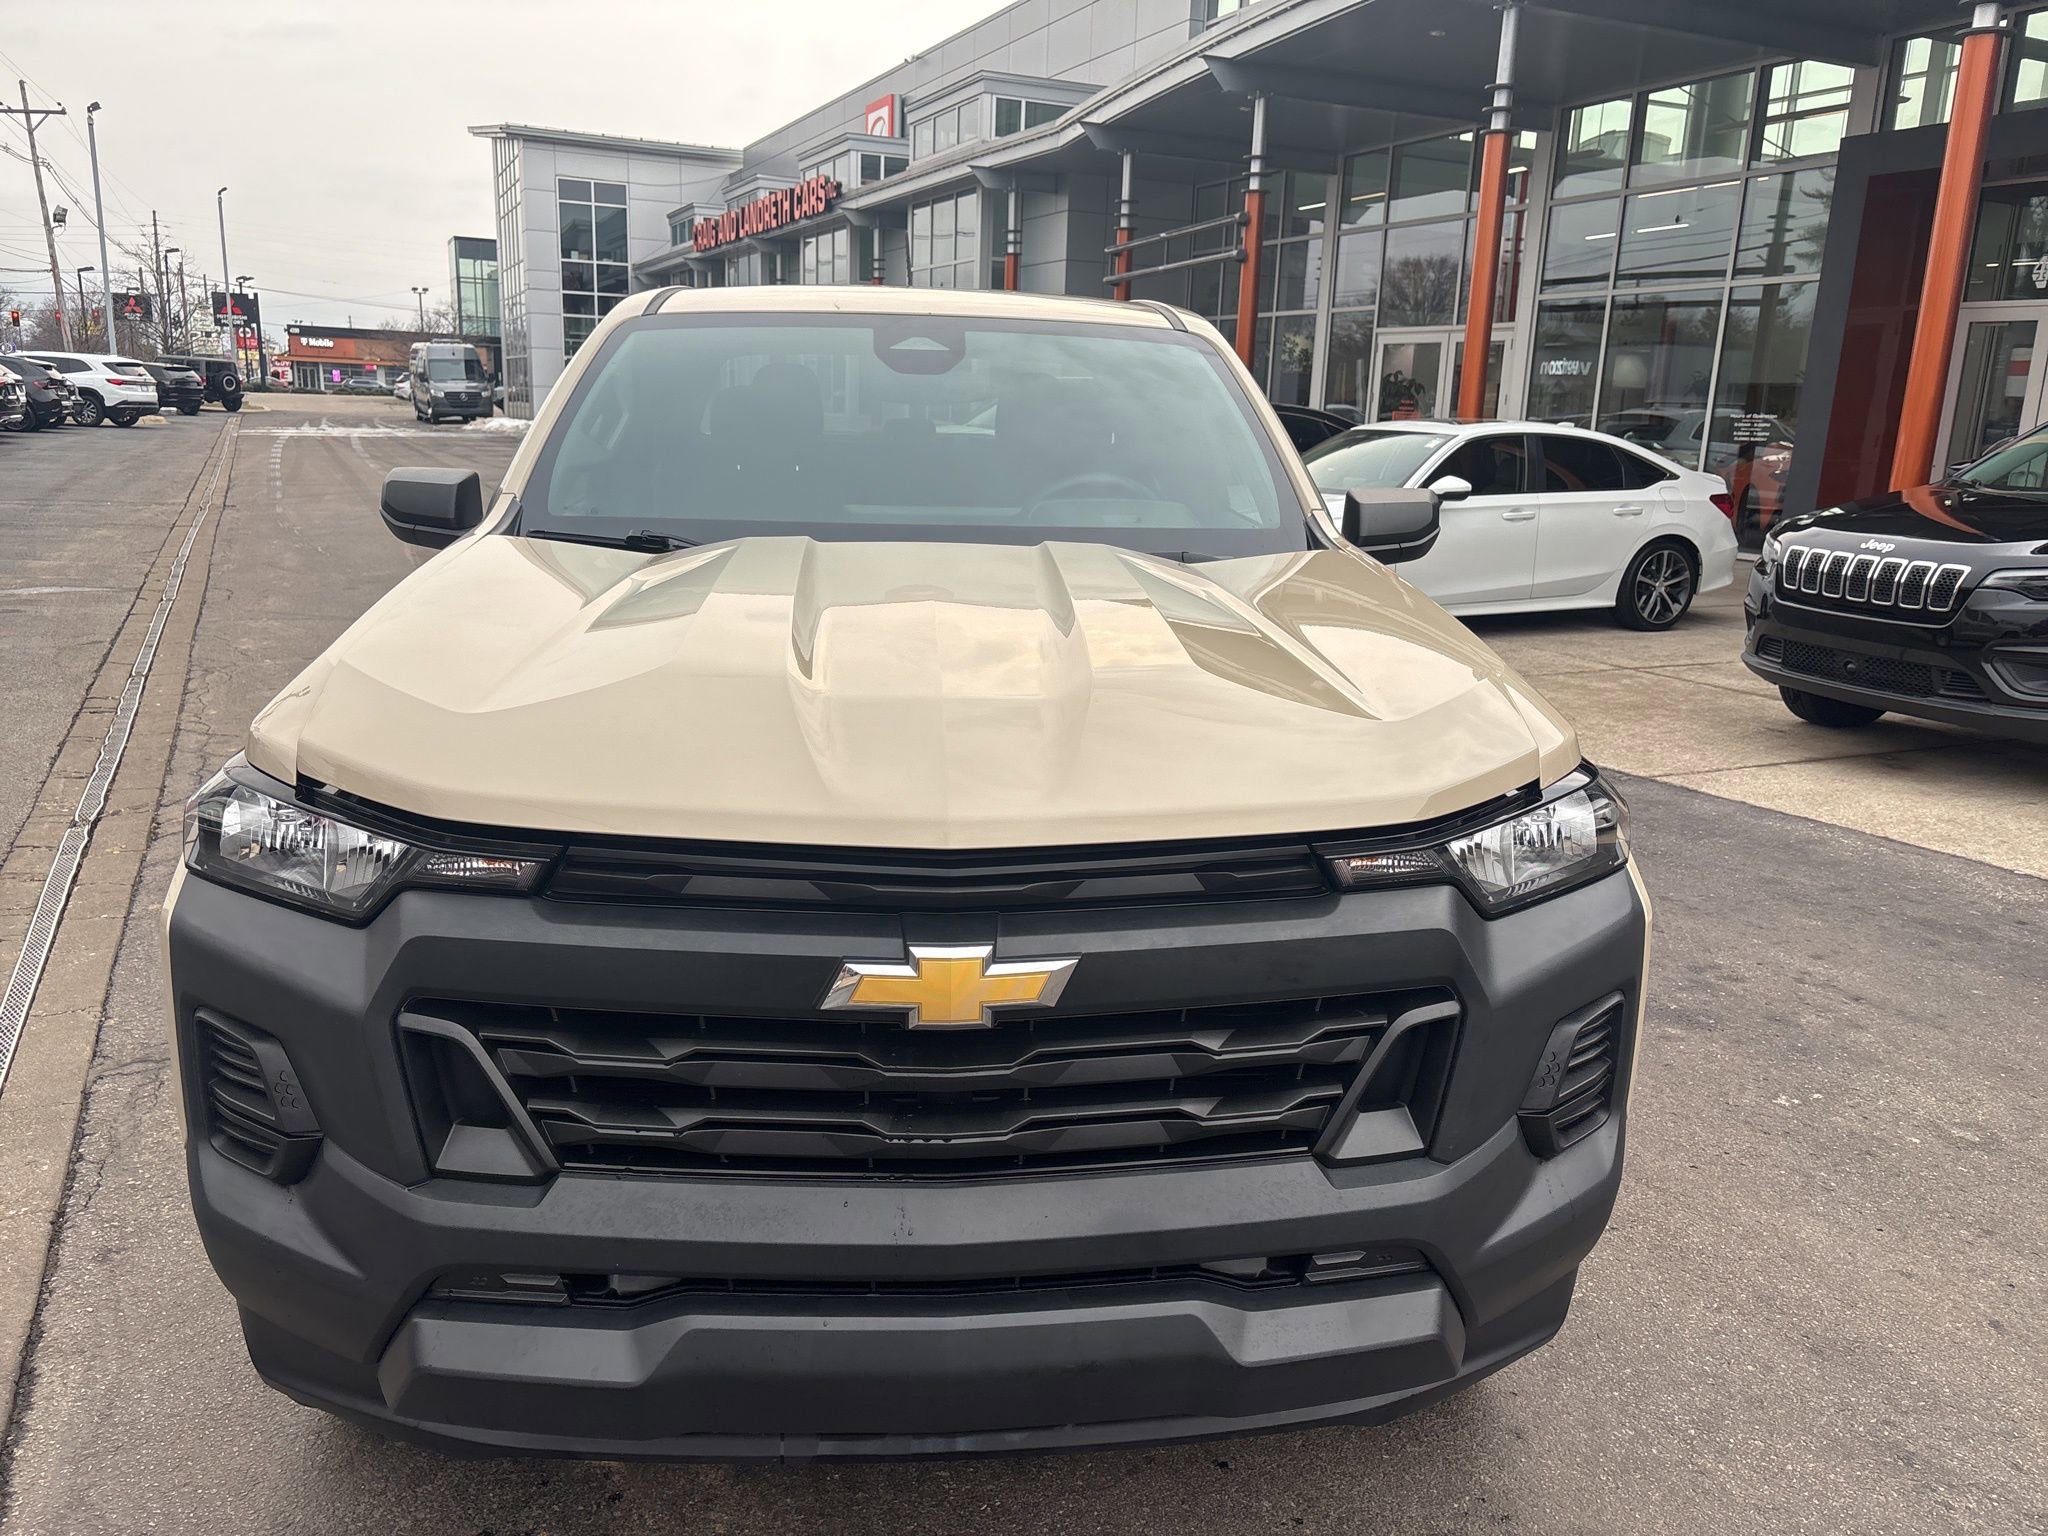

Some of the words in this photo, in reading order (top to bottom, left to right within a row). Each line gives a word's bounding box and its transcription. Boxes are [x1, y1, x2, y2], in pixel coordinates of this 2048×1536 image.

[693, 221, 715, 252] CRAIG
[717, 210, 738, 245] AND
[739, 188, 791, 238] LANDRETH
[793, 175, 826, 220] CARS
[1860, 539, 1896, 553] Jeep
